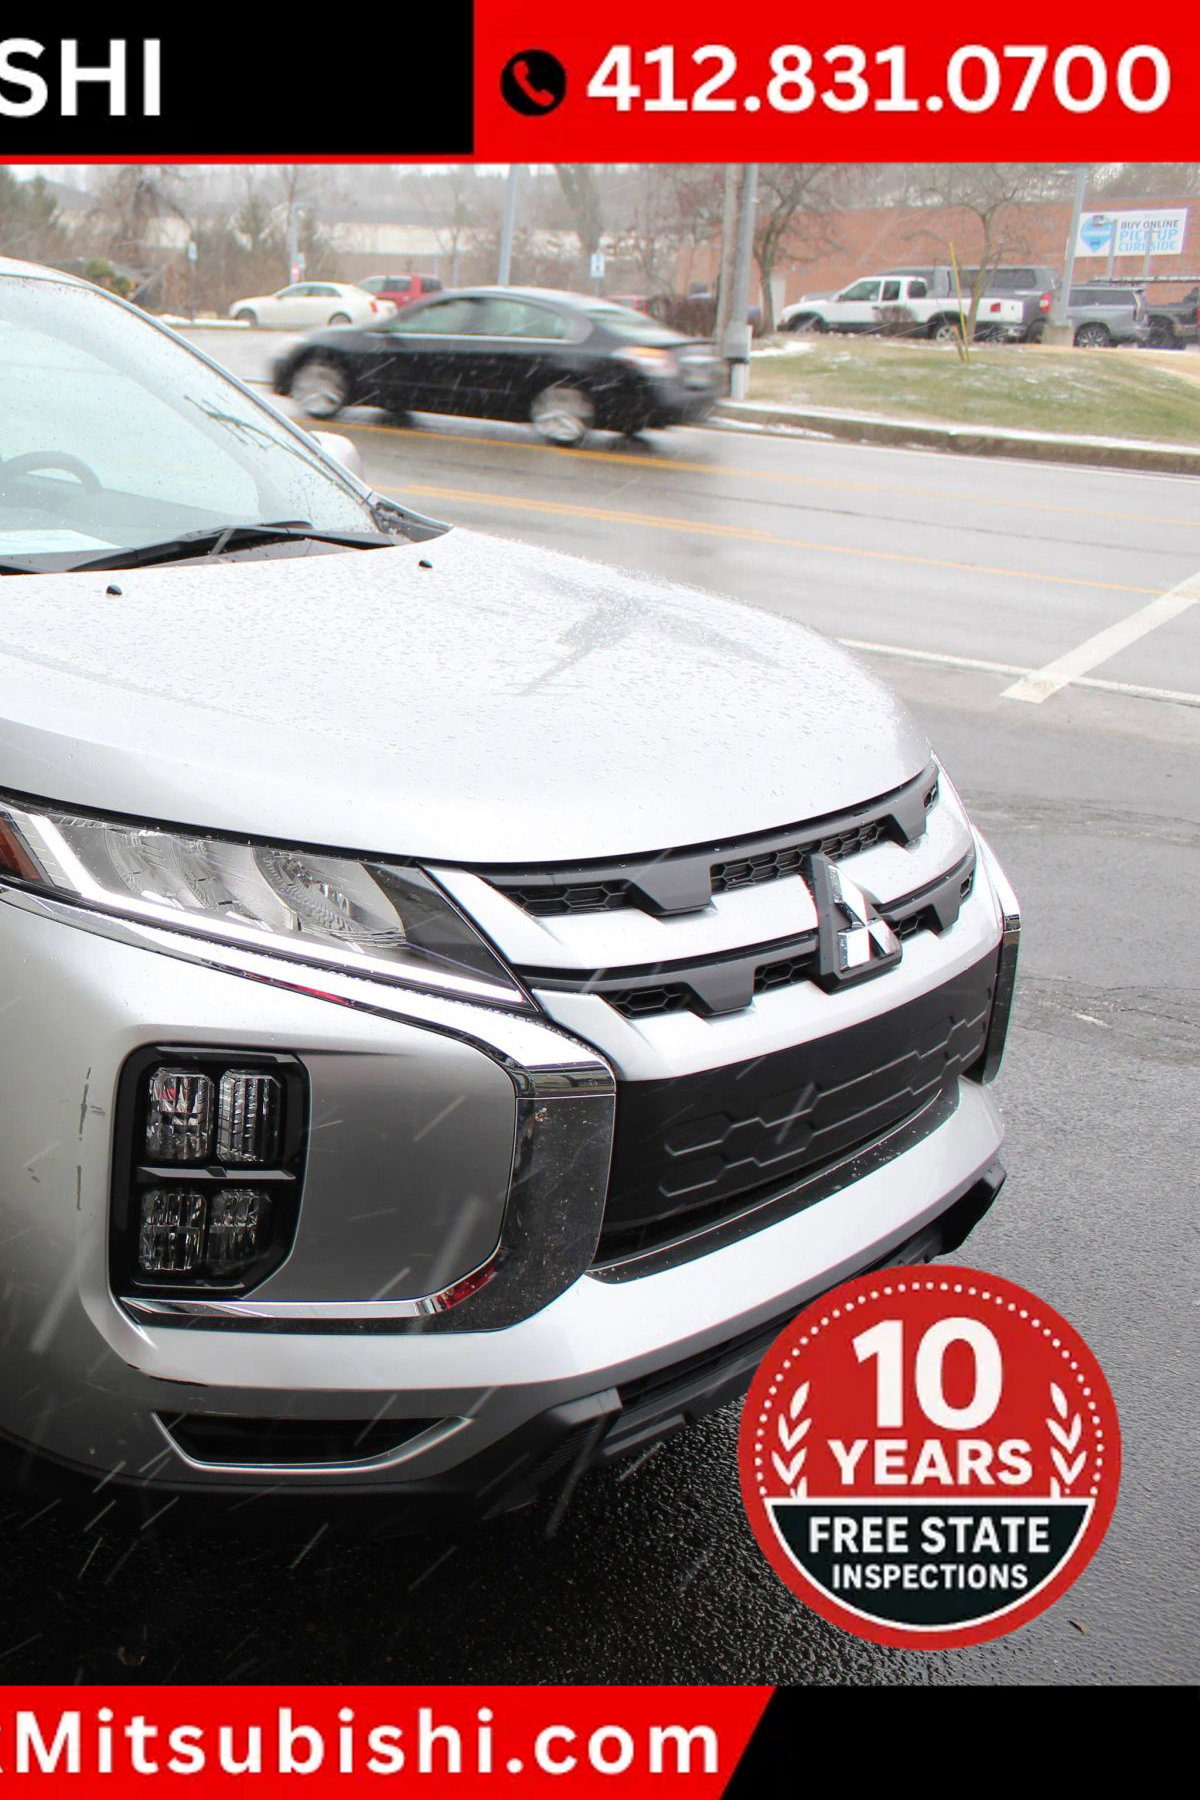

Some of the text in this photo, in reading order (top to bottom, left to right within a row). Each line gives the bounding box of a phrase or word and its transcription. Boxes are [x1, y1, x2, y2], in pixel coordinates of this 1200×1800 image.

[1120, 219, 1180, 229] BUY ONLINE
[1157, 228, 1178, 241] UP
